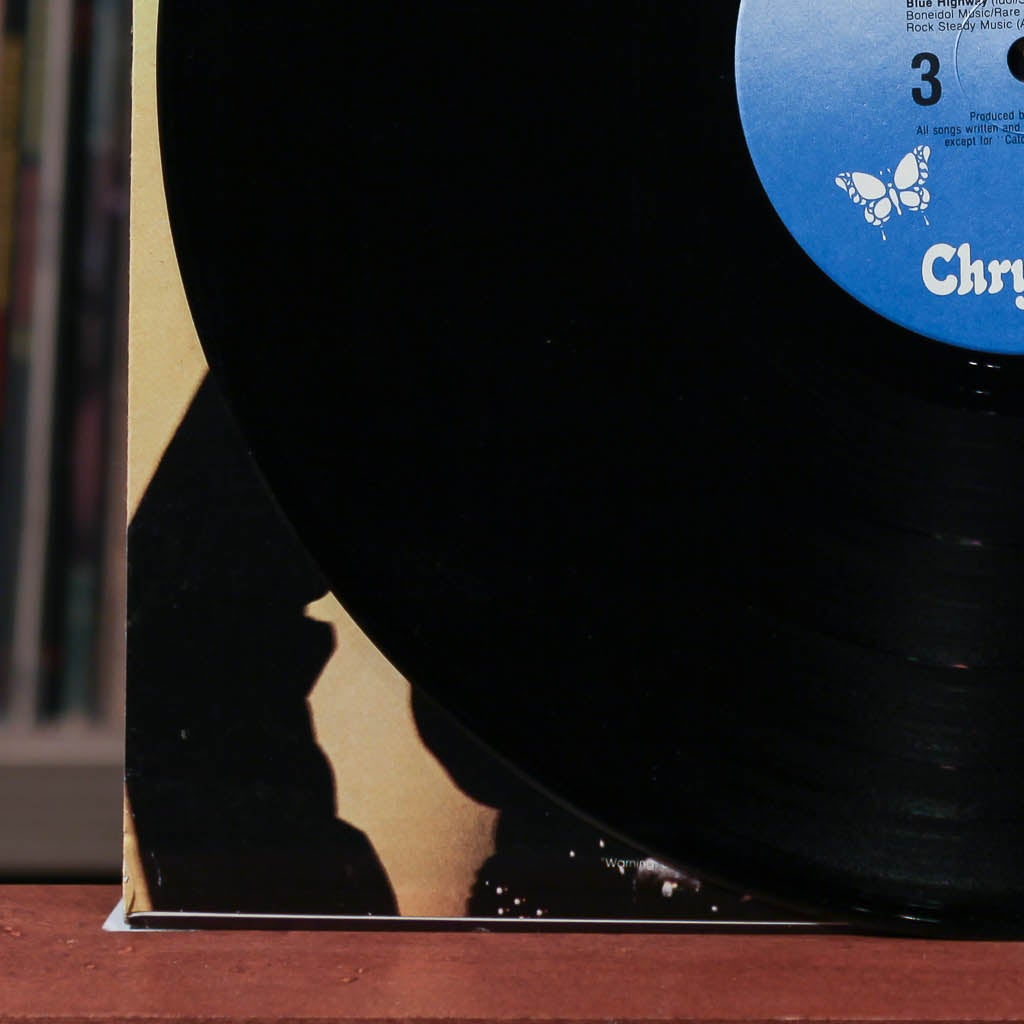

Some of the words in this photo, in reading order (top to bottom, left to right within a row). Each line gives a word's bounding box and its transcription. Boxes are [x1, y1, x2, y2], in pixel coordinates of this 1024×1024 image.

[906, 10, 954, 21] Boneidol
[958, 7, 1020, 19] Music/Rare
[906, 22, 934, 32] Rock
[938, 21, 976, 33] Steady
[980, 19, 1013, 30] Music
[911, 52, 942, 106] 3
[969, 111, 1015, 121] Produced
[916, 125, 929, 136] All
[933, 126, 962, 137] songs
[965, 124, 999, 134] written
[1002, 123, 1020, 133] and
[944, 136, 976, 148] except
[980, 135, 993, 145] for
